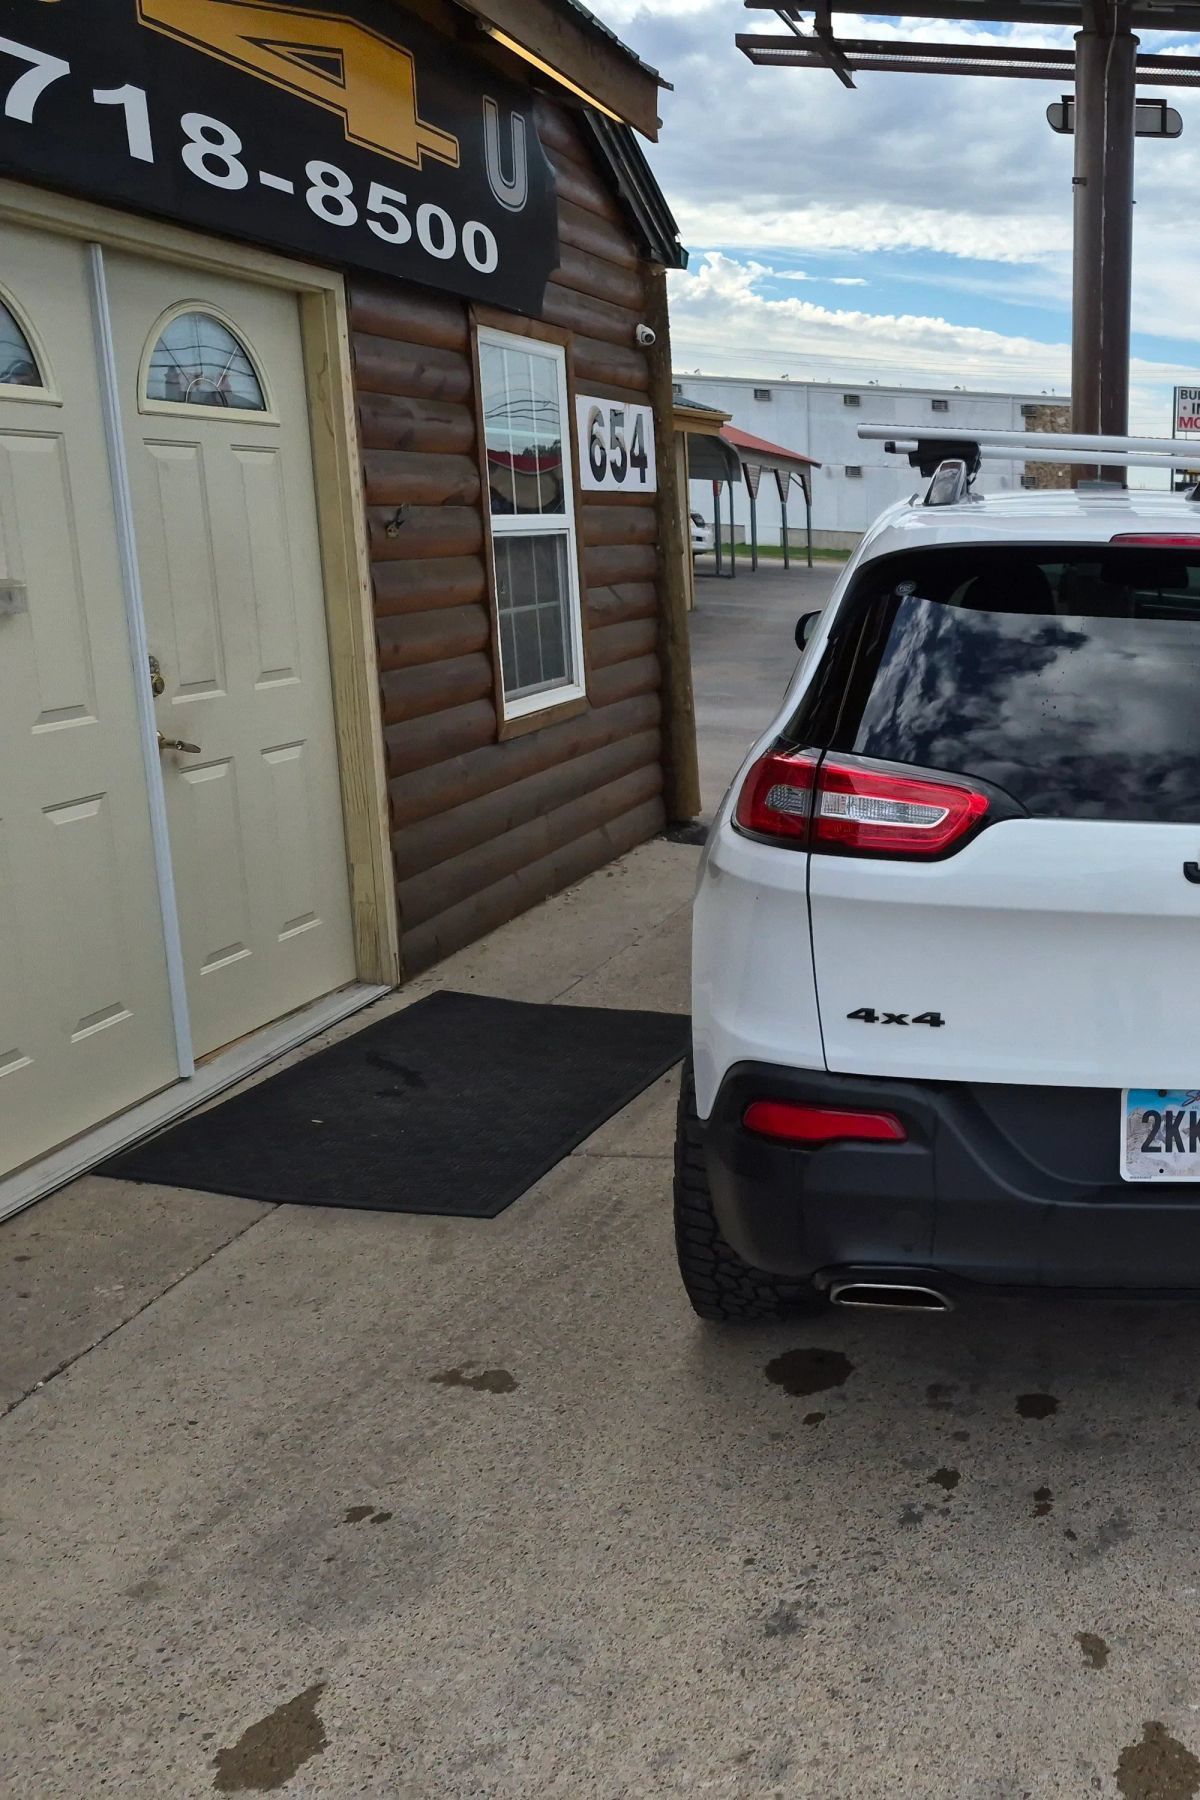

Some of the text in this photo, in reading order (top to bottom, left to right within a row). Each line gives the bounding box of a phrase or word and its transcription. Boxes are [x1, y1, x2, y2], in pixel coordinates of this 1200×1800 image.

[0, 37, 499, 274] 718-8500
[482, 95, 529, 212] U
[588, 405, 648, 483] 654
[846, 1007, 945, 1028] 4x4
